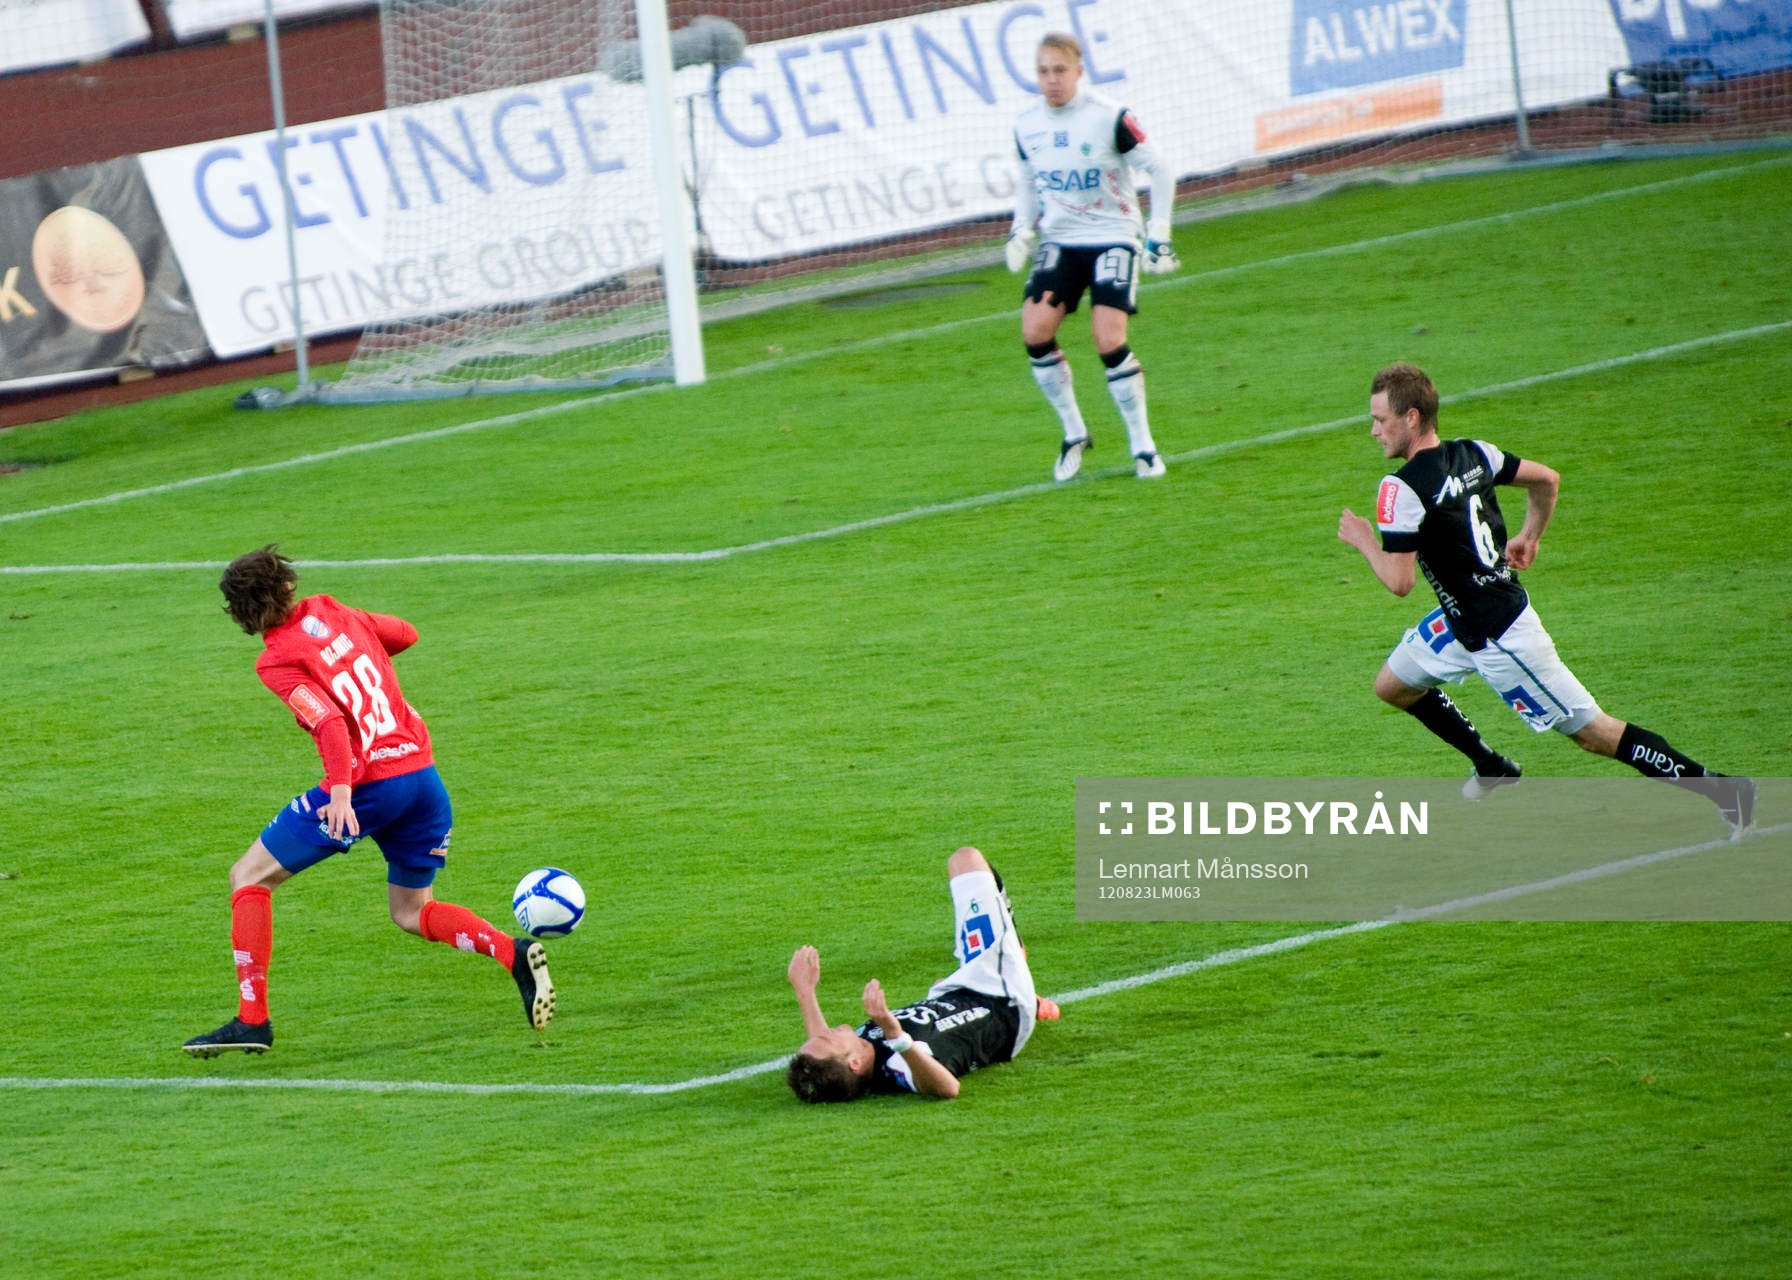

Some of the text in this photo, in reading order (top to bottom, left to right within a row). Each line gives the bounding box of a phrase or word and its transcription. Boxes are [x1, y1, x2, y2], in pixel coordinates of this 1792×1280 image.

[713, 0, 1126, 148] GETINGE
[1304, 0, 1463, 66] ALWEX
[193, 82, 626, 240] GETINGE
[753, 157, 966, 241] GETINGE
[240, 217, 655, 335] GETINGE GROUP
[1383, 484, 1399, 522] Adecco
[1469, 494, 1499, 568] 6
[331, 653, 397, 753] 28
